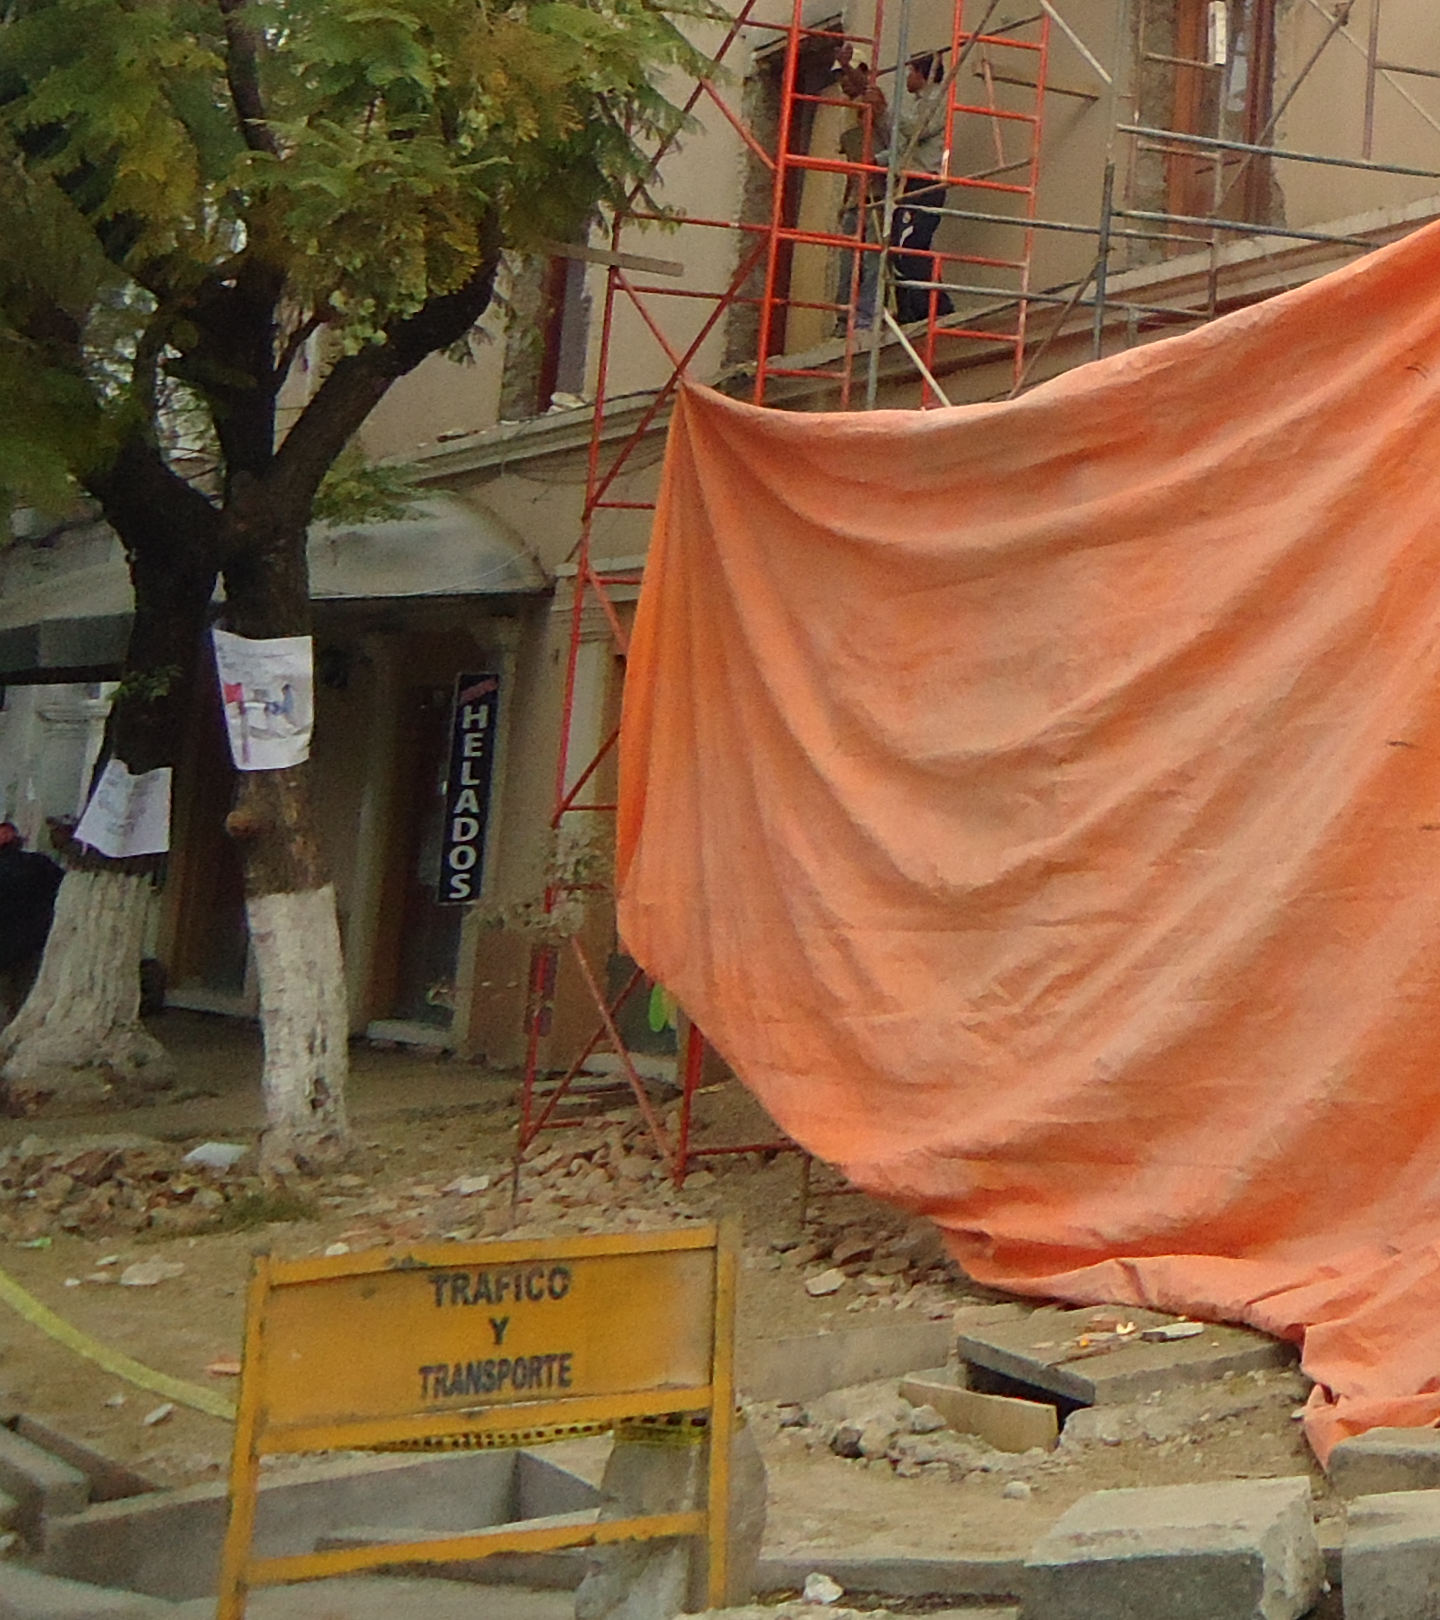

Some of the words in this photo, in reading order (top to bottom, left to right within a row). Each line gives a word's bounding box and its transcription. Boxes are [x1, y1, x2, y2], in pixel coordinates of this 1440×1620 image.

[449, 704, 489, 899] HELADOS
[429, 1266, 571, 1307] TRAFICO
[489, 1317, 510, 1345] Y
[418, 1352, 574, 1399] TRANSPORTE
